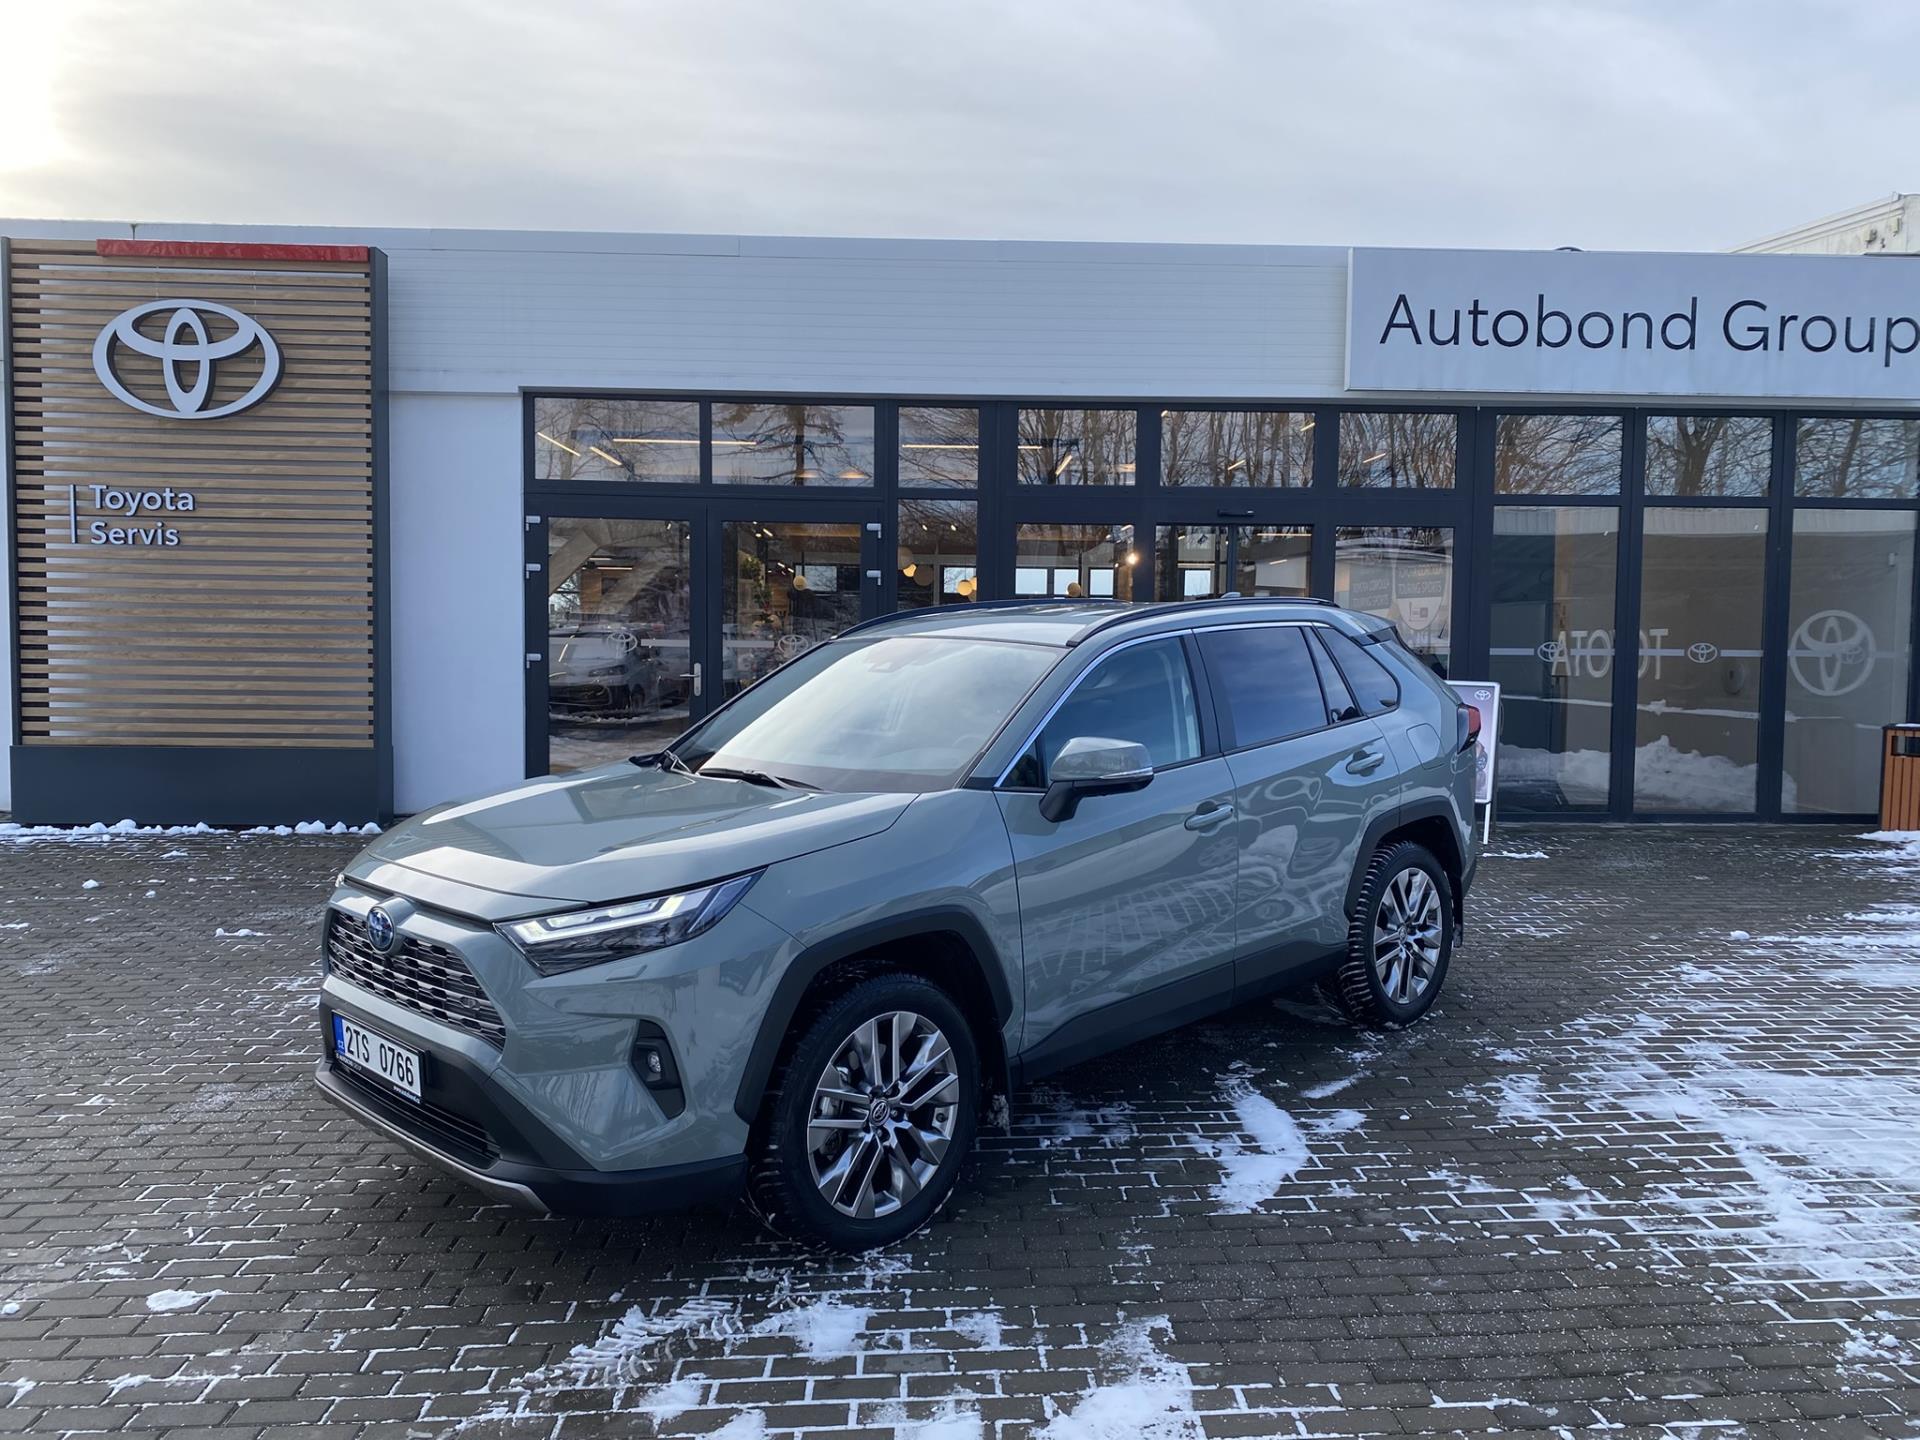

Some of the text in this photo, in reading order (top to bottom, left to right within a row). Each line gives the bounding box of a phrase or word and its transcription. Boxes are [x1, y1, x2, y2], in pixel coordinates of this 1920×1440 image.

[1379, 293, 1920, 368] Autobond Group
[89, 484, 195, 517] Toyota
[90, 521, 180, 546] Servis
[345, 1025, 370, 1063] 2TS
[379, 1042, 414, 1087] 0766
